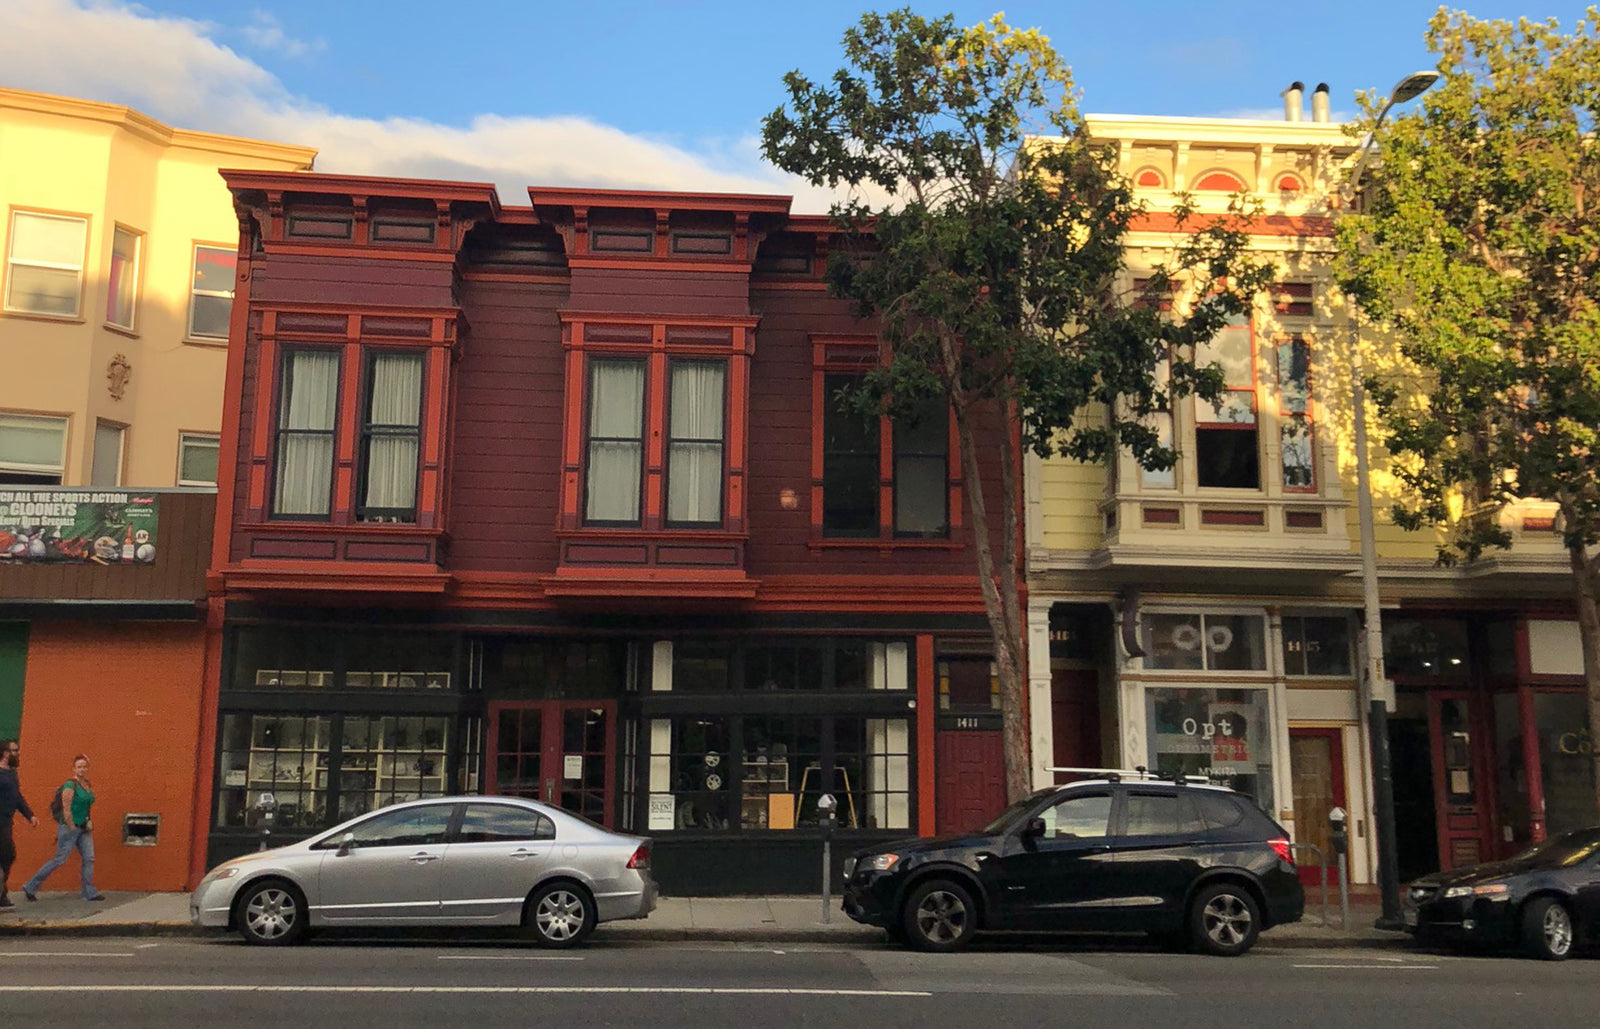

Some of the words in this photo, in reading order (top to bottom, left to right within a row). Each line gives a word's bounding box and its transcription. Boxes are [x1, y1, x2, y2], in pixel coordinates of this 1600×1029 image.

[15, 492, 31, 502] ALL
[33, 492, 51, 503] THE
[53, 493, 90, 503] SPORTS
[91, 493, 127, 504] ACTION
[10, 502, 77, 516] CLOONEYS
[957, 717, 978, 728] 1411
[1183, 717, 1232, 740] Opt
